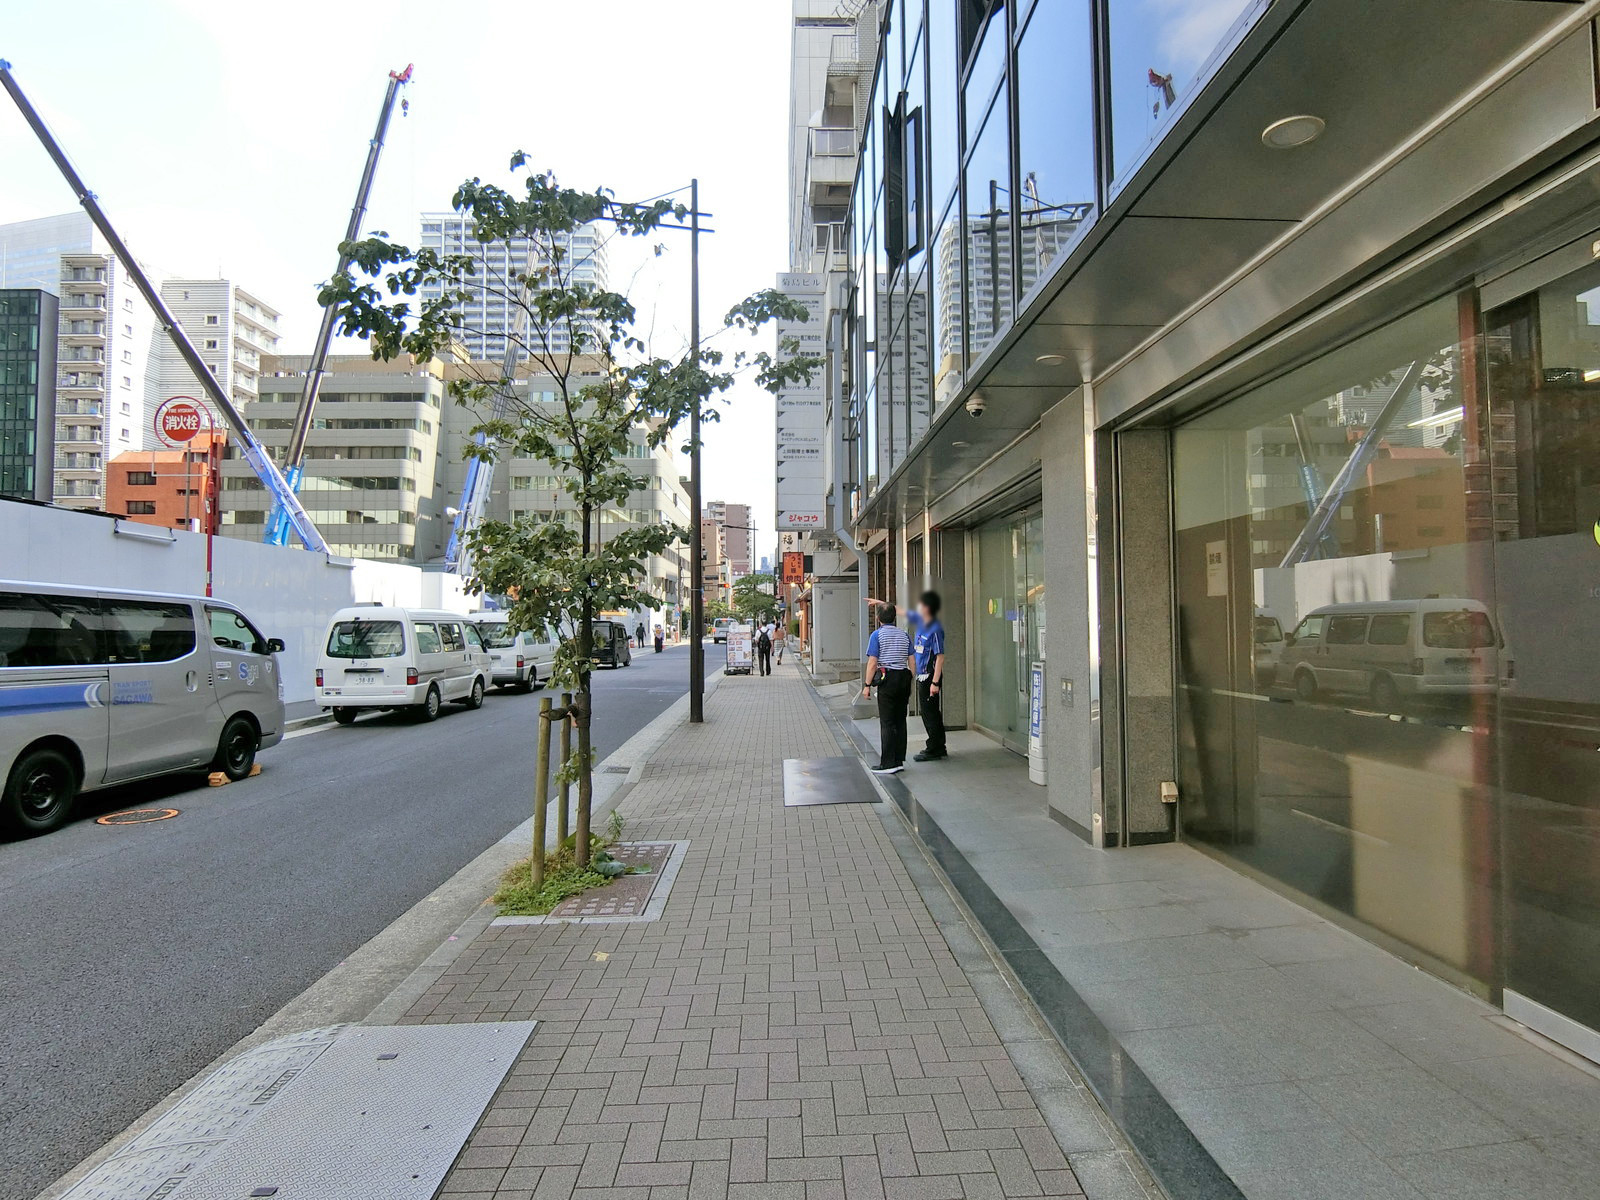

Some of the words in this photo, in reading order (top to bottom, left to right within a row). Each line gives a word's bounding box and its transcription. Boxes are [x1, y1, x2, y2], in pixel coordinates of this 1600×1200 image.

[165, 415, 199, 430] 消火栓
[789, 514, 818, 522] ジャコウ
[786, 575, 802, 583] 焼肉
[112, 693, 153, 705] SAGAWA
